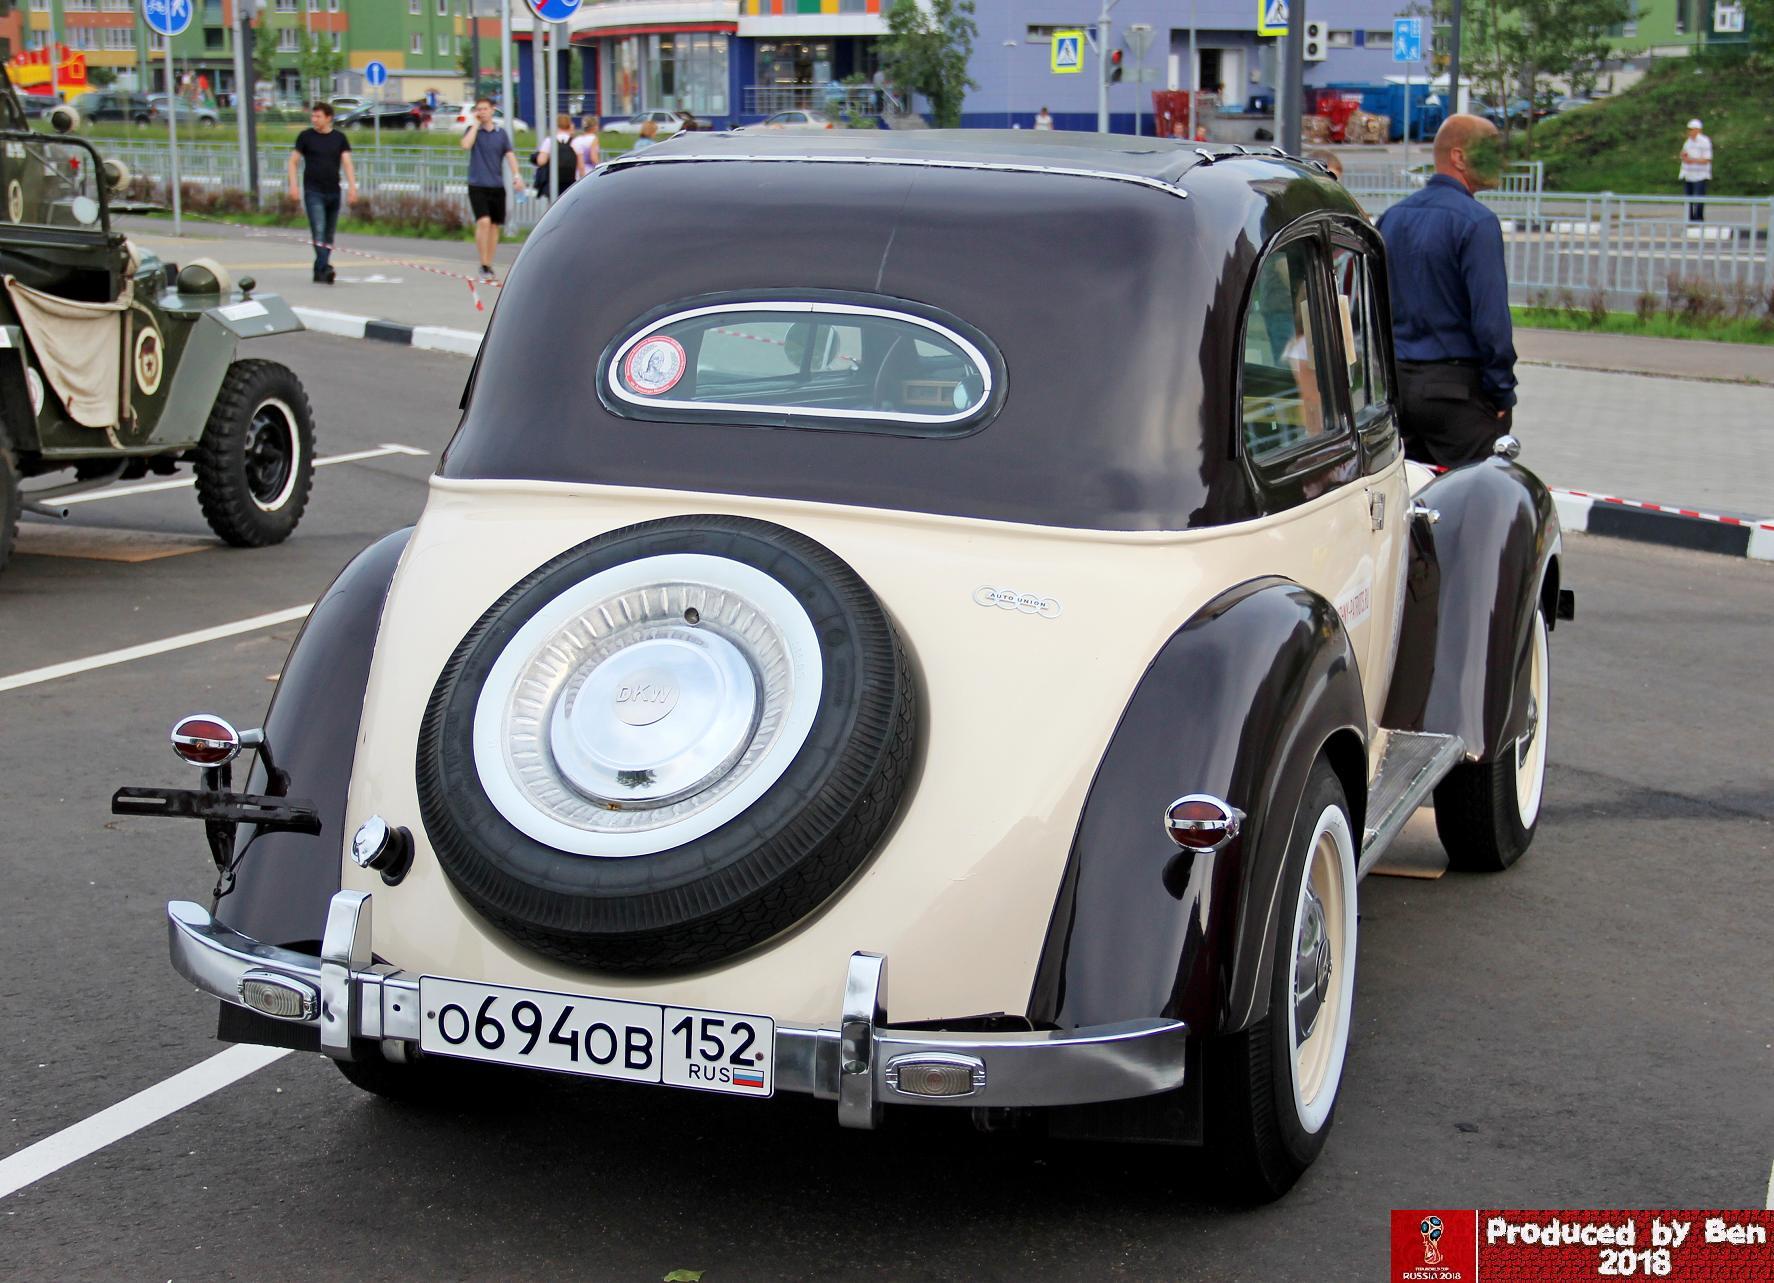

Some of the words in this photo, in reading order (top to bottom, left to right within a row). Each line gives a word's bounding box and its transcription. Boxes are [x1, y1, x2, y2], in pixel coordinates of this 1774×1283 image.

[990, 592, 1014, 601] AUTO
[1017, 597, 1046, 607] UNION
[616, 685, 673, 704] DKW
[671, 1015, 757, 1067] 152
[688, 1063, 731, 1083] RUS
